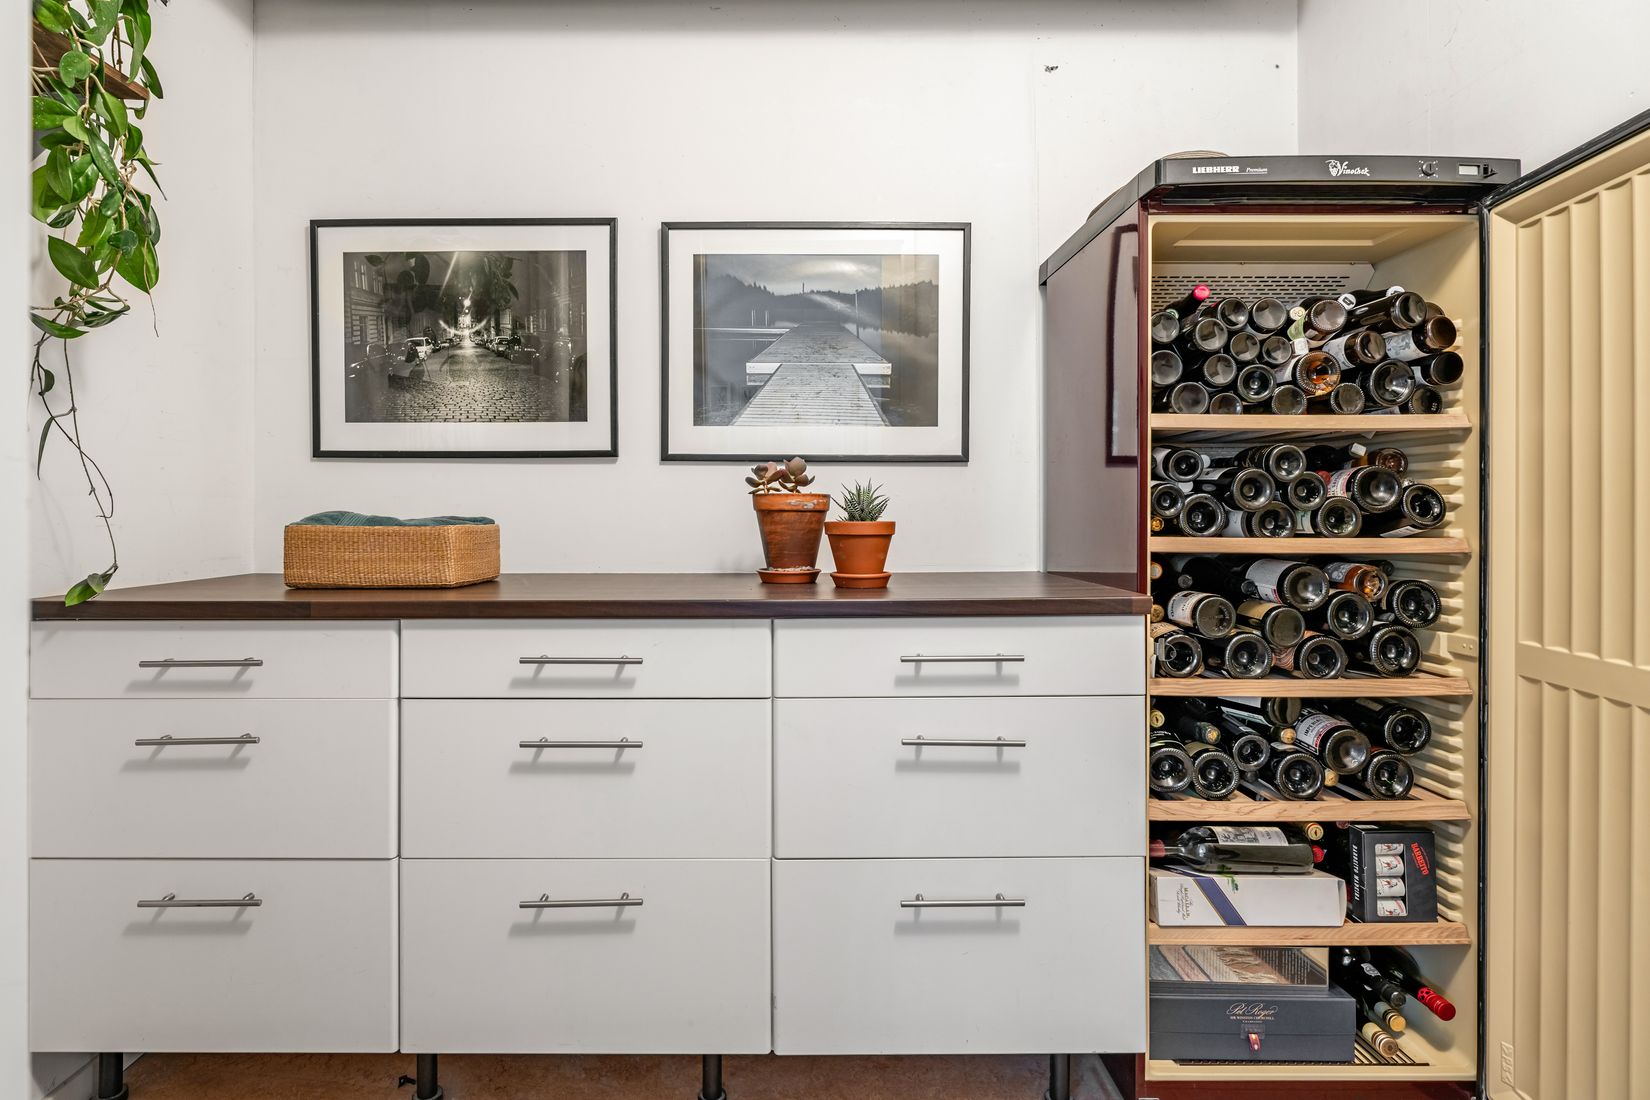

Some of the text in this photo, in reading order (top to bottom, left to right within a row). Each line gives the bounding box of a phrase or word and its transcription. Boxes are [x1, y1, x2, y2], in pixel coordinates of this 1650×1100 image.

[1192, 166, 1240, 174] LIEBHERR
[1335, 161, 1371, 177] Vinothek
[1411, 842, 1430, 875] BARBEITO
[1245, 1002, 1278, 1018] Roger
